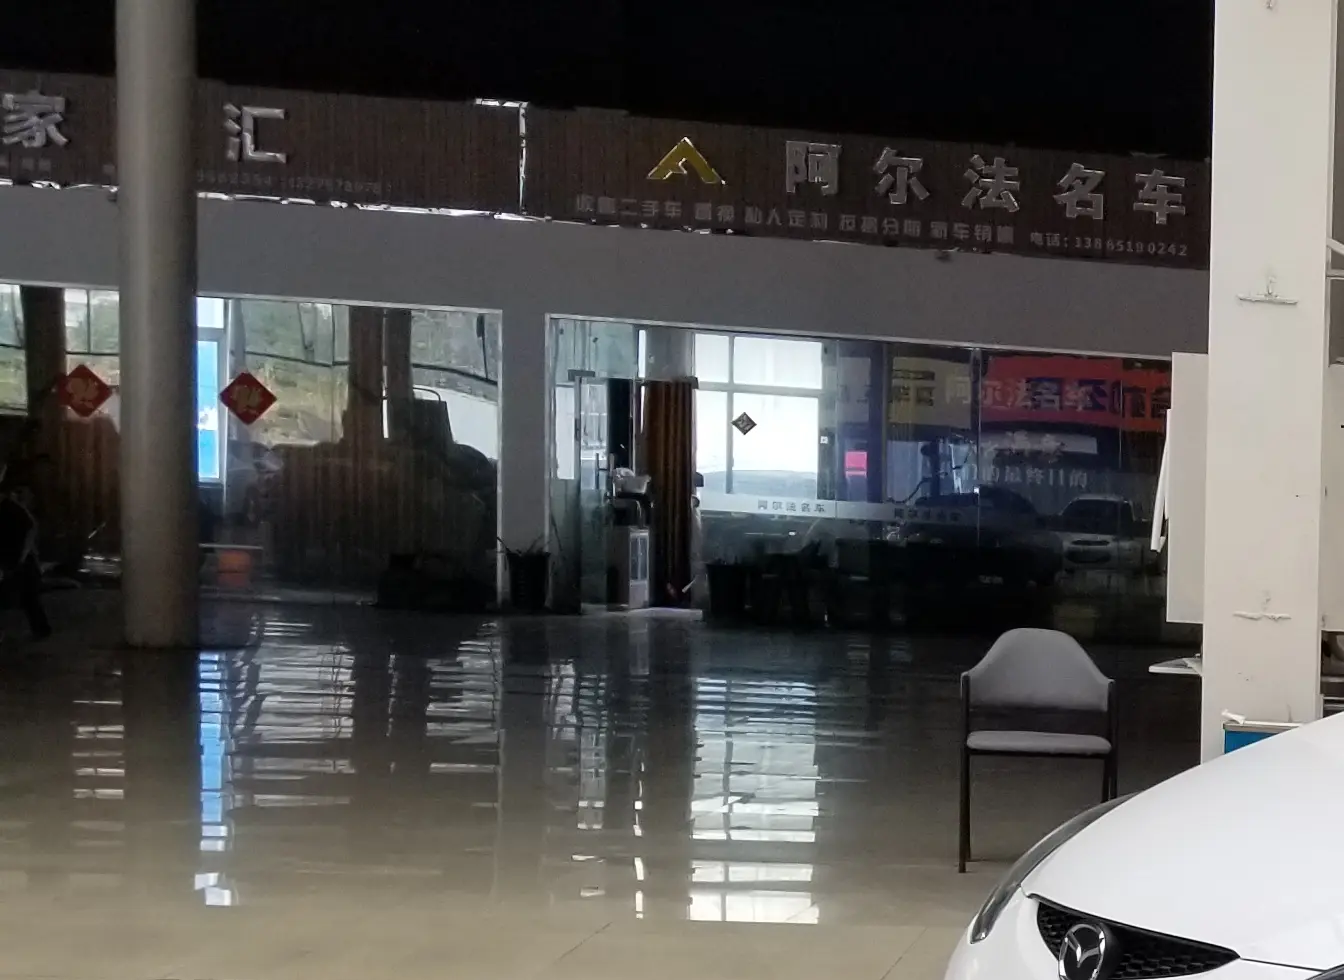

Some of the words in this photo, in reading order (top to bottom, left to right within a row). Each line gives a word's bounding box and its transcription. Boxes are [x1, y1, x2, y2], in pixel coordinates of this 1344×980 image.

[785, 141, 1187, 224] 阿尔法名车
